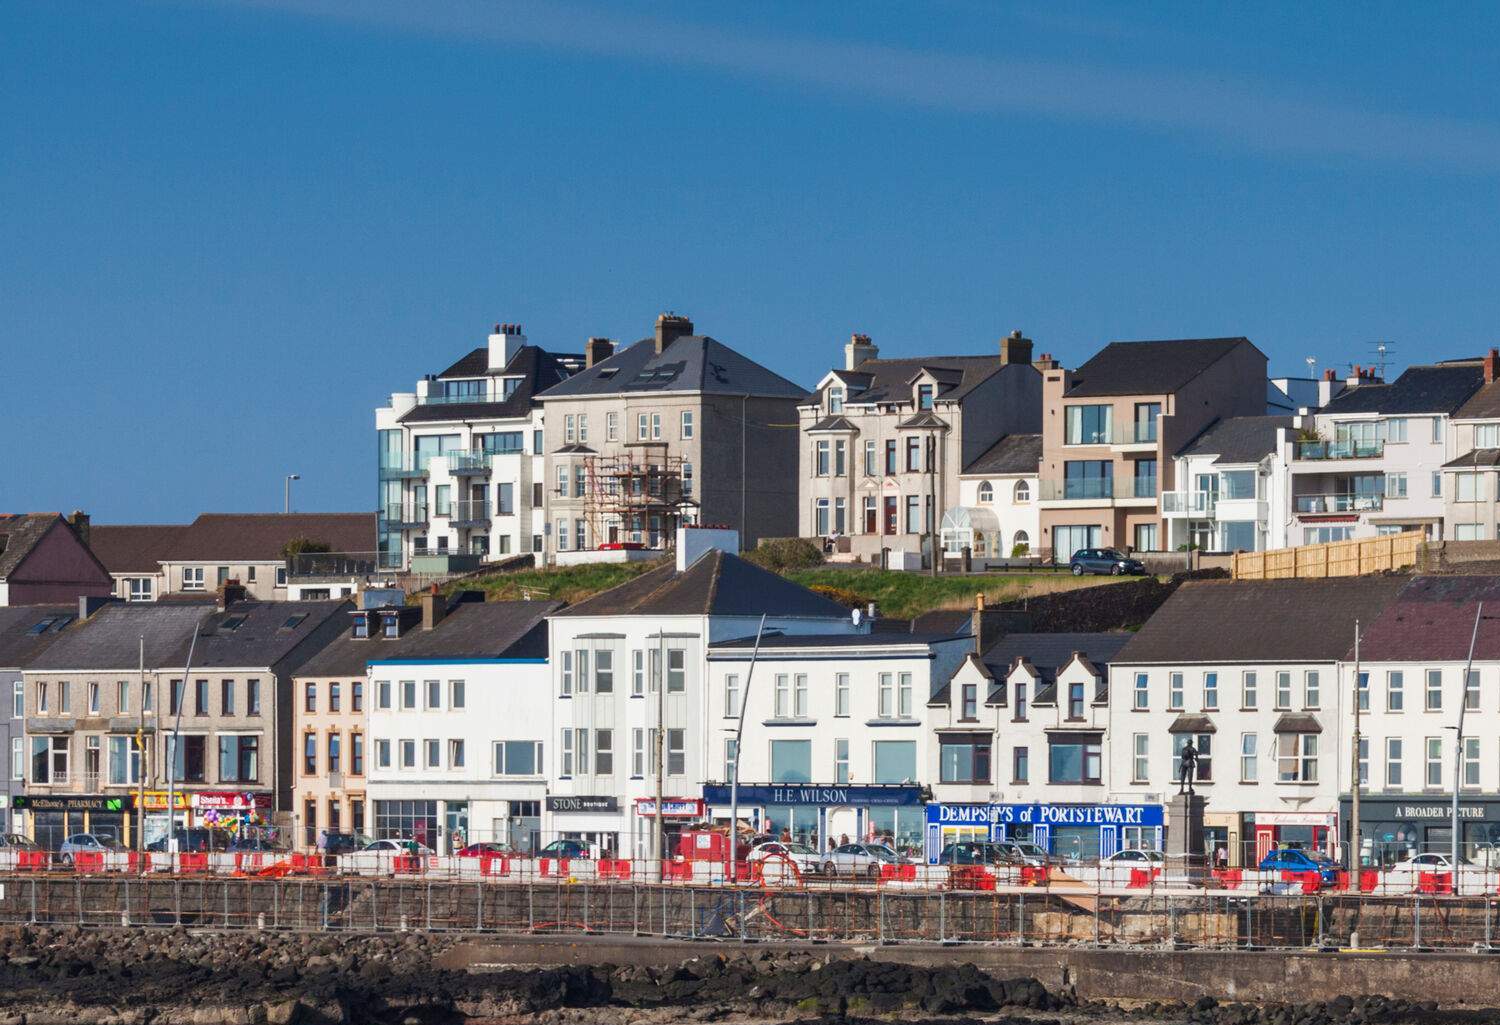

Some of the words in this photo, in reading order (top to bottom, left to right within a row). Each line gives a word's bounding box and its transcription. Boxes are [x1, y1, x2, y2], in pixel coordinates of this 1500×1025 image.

[774, 789, 798, 803] H.E.
[800, 789, 848, 803] WILSON
[67, 799, 103, 808] PHARMACY
[553, 800, 582, 810] STONE
[940, 806, 1014, 822] DEMPSYS
[1019, 808, 1033, 822] of
[1041, 807, 1145, 823] PORTSTEWART
[1395, 807, 1402, 817] A
[1404, 806, 1444, 818] BROADER
[1446, 807, 1485, 818] PCTURE
